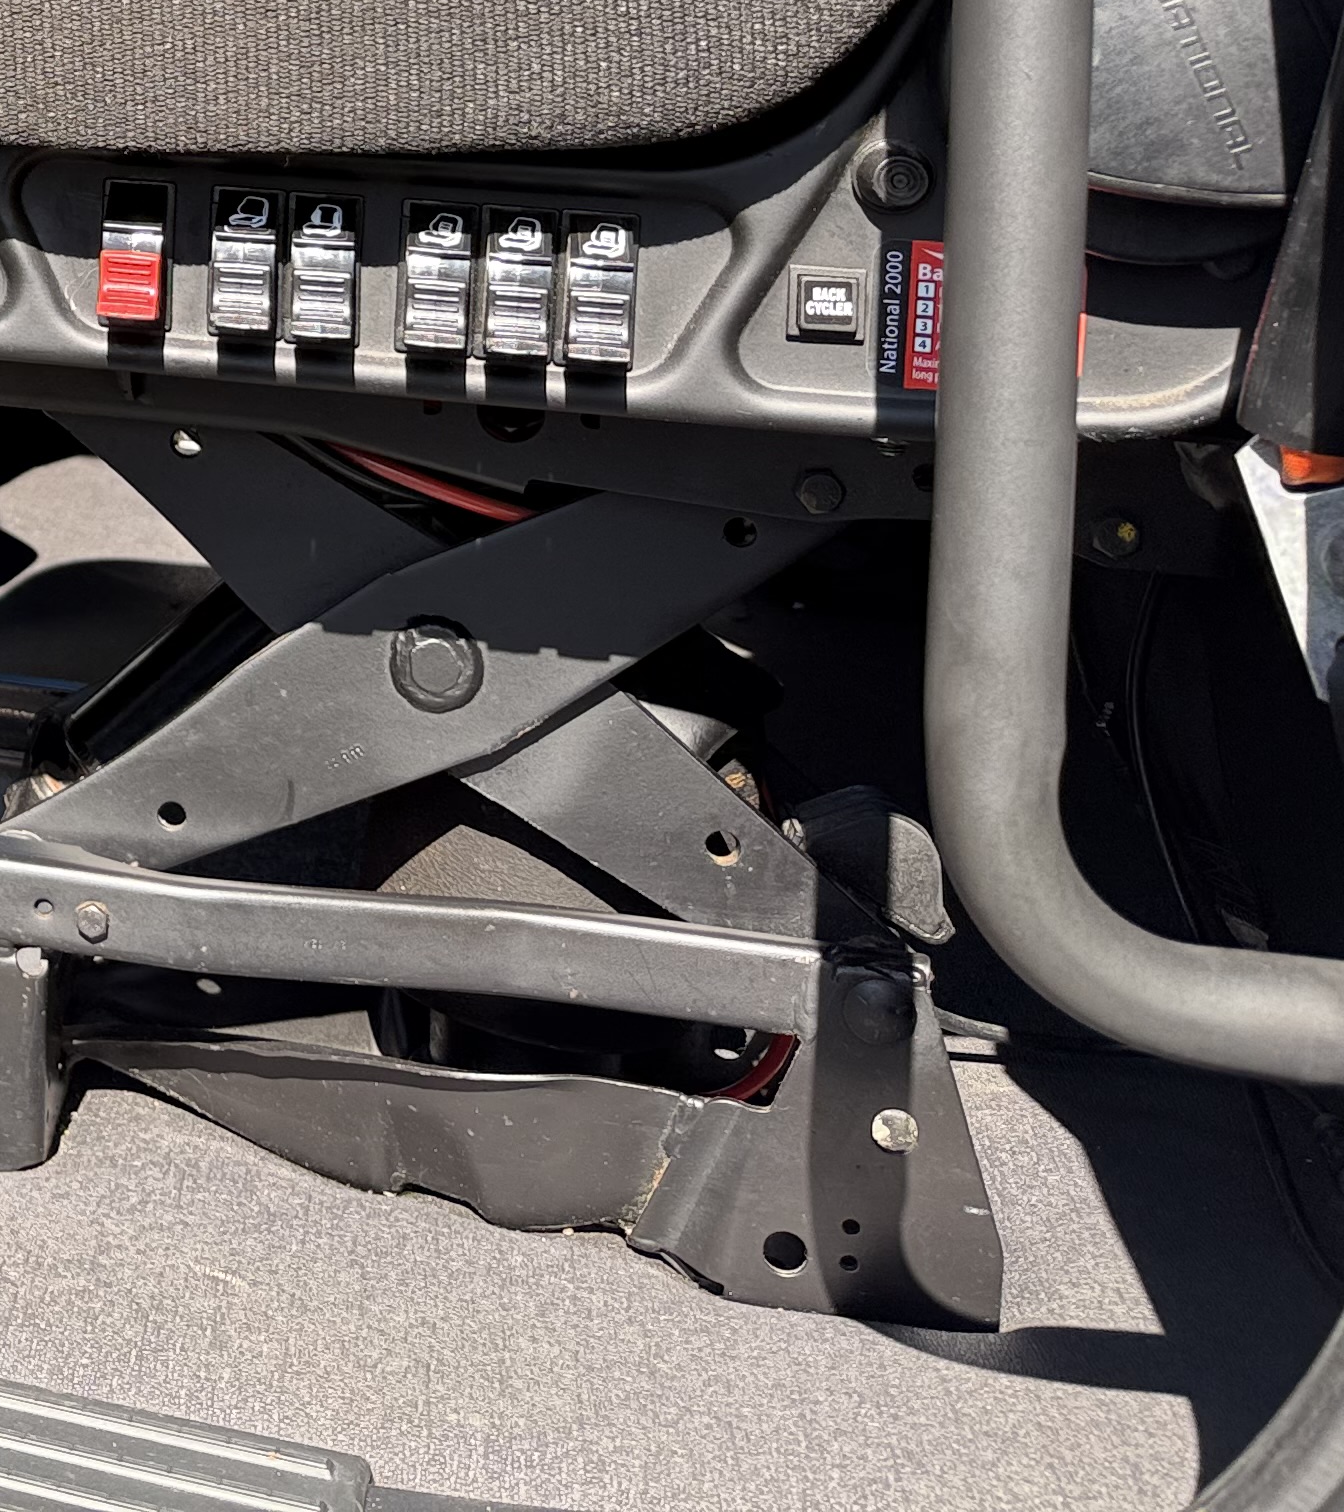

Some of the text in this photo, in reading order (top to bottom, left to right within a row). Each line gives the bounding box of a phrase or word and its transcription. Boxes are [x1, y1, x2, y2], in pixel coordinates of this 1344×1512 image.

[812, 287, 846, 301] BACK
[805, 301, 853, 317] CYCLER
[879, 250, 904, 374] National 2000
[912, 369, 933, 383] long
